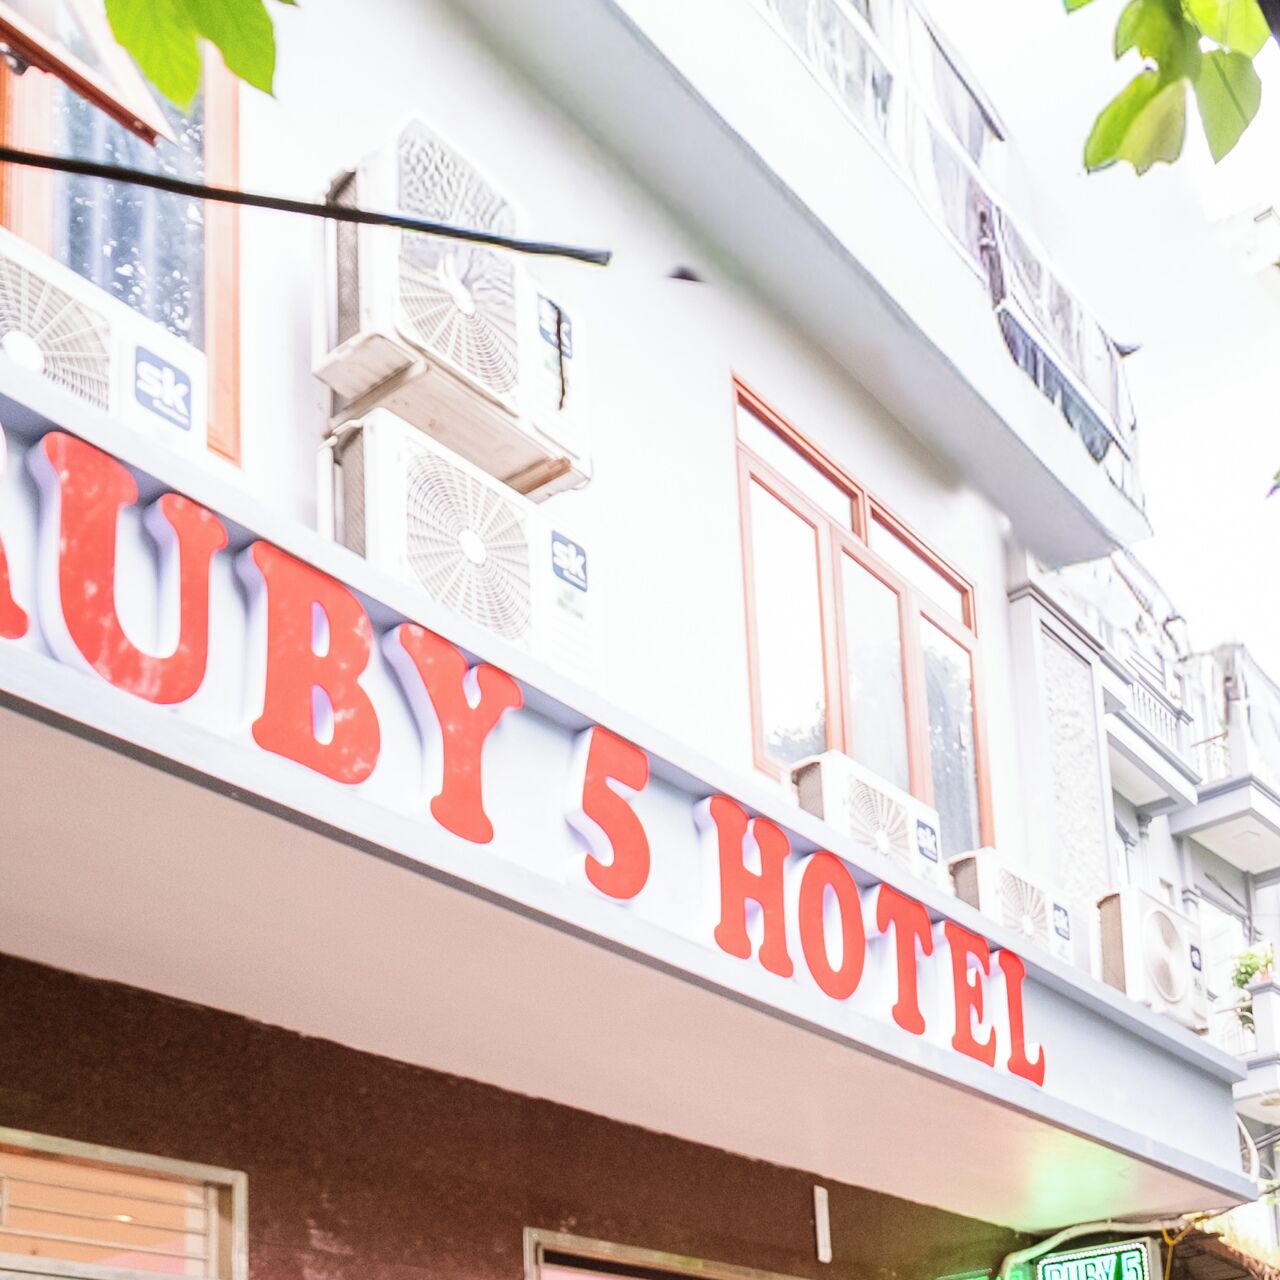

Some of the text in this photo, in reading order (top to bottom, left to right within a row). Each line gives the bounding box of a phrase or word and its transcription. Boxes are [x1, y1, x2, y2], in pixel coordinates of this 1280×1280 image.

[136, 360, 190, 417] sk
[552, 541, 586, 582] sk
[582, 726, 650, 900] 5
[709, 795, 1046, 1087] HOTEL
